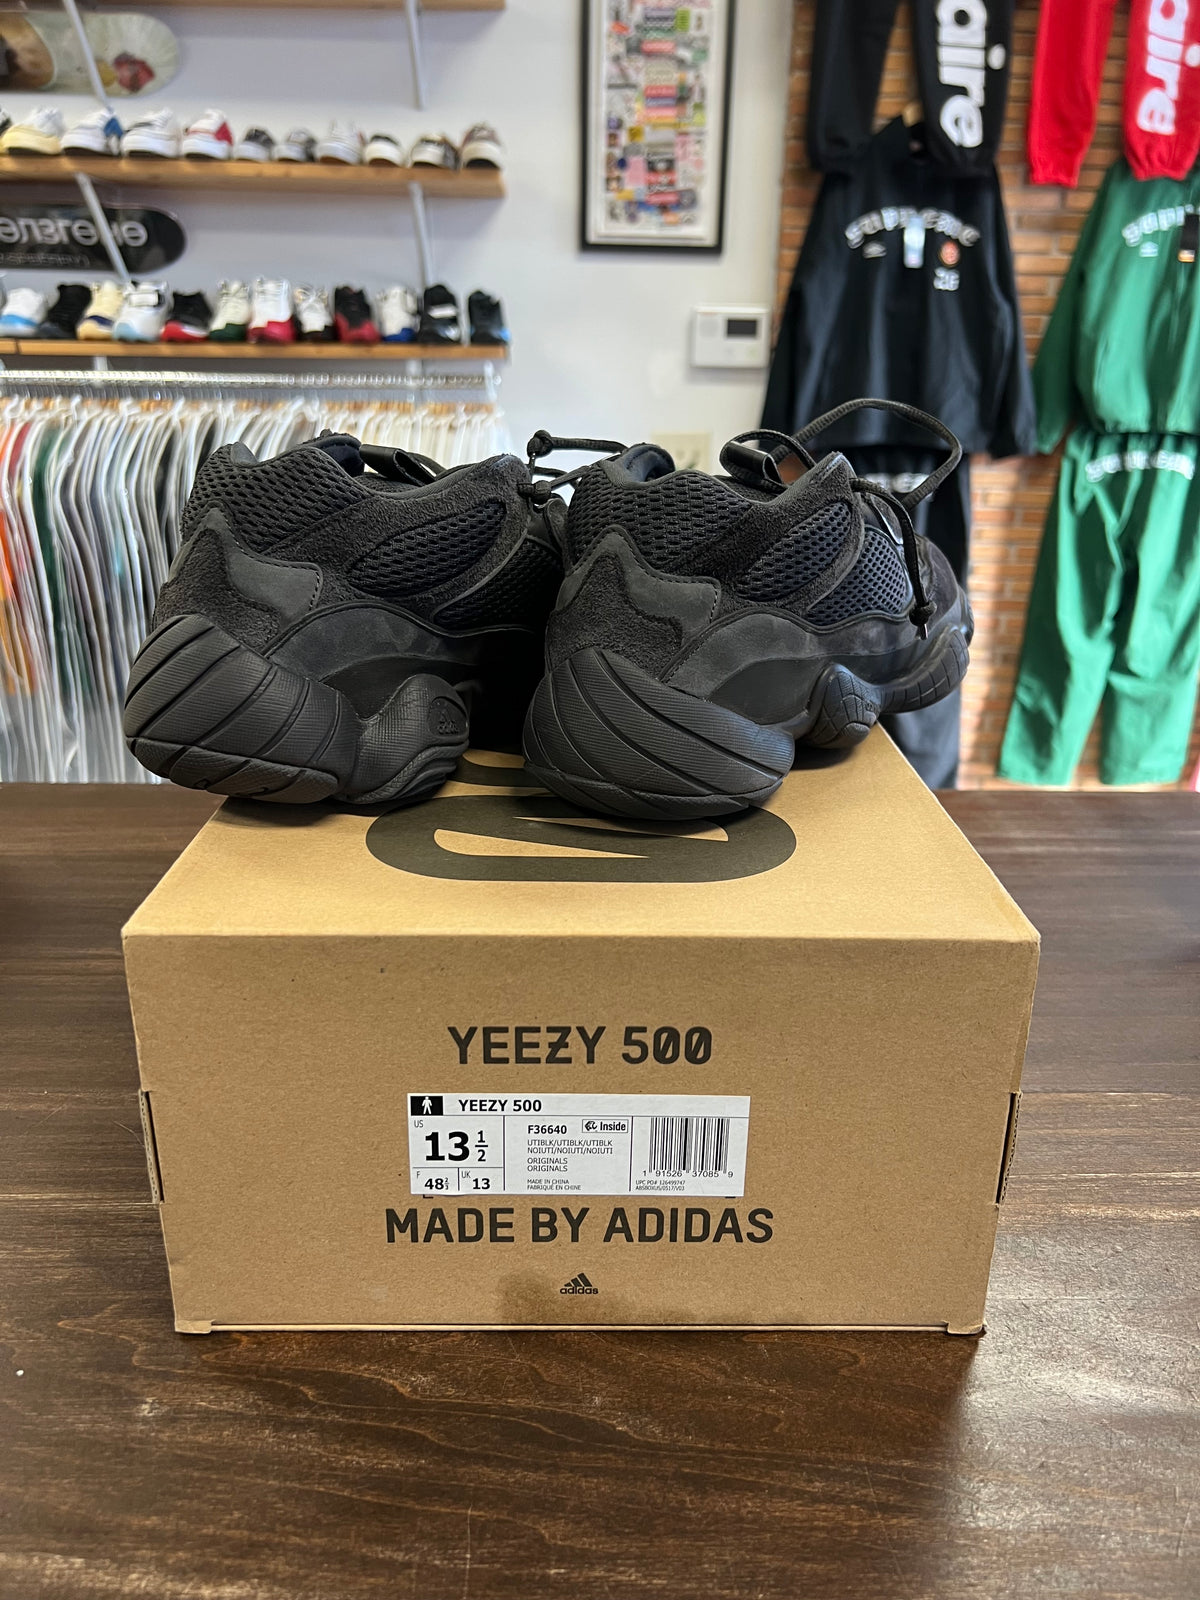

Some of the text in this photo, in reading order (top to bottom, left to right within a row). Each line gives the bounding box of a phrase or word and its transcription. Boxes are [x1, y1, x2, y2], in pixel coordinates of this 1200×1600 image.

[447, 1026, 713, 1065] YEEZY 500
[458, 1099, 542, 1112] YEEZY 500
[413, 1119, 424, 1128] US
[599, 1121, 626, 1131] Inside
[527, 1124, 568, 1135] F36640
[425, 1131, 470, 1161] 13
[527, 1157, 568, 1165] ORIGINALS
[416, 1170, 421, 1179] F
[461, 1170, 471, 1179] UK
[655, 1170, 683, 1178] 91526
[692, 1170, 720, 1178] 37085
[424, 1178, 445, 1190] 48
[472, 1178, 491, 1190] 13
[385, 1207, 774, 1244] MADE BY ADIDAS
[559, 1286, 599, 1295] adidas
